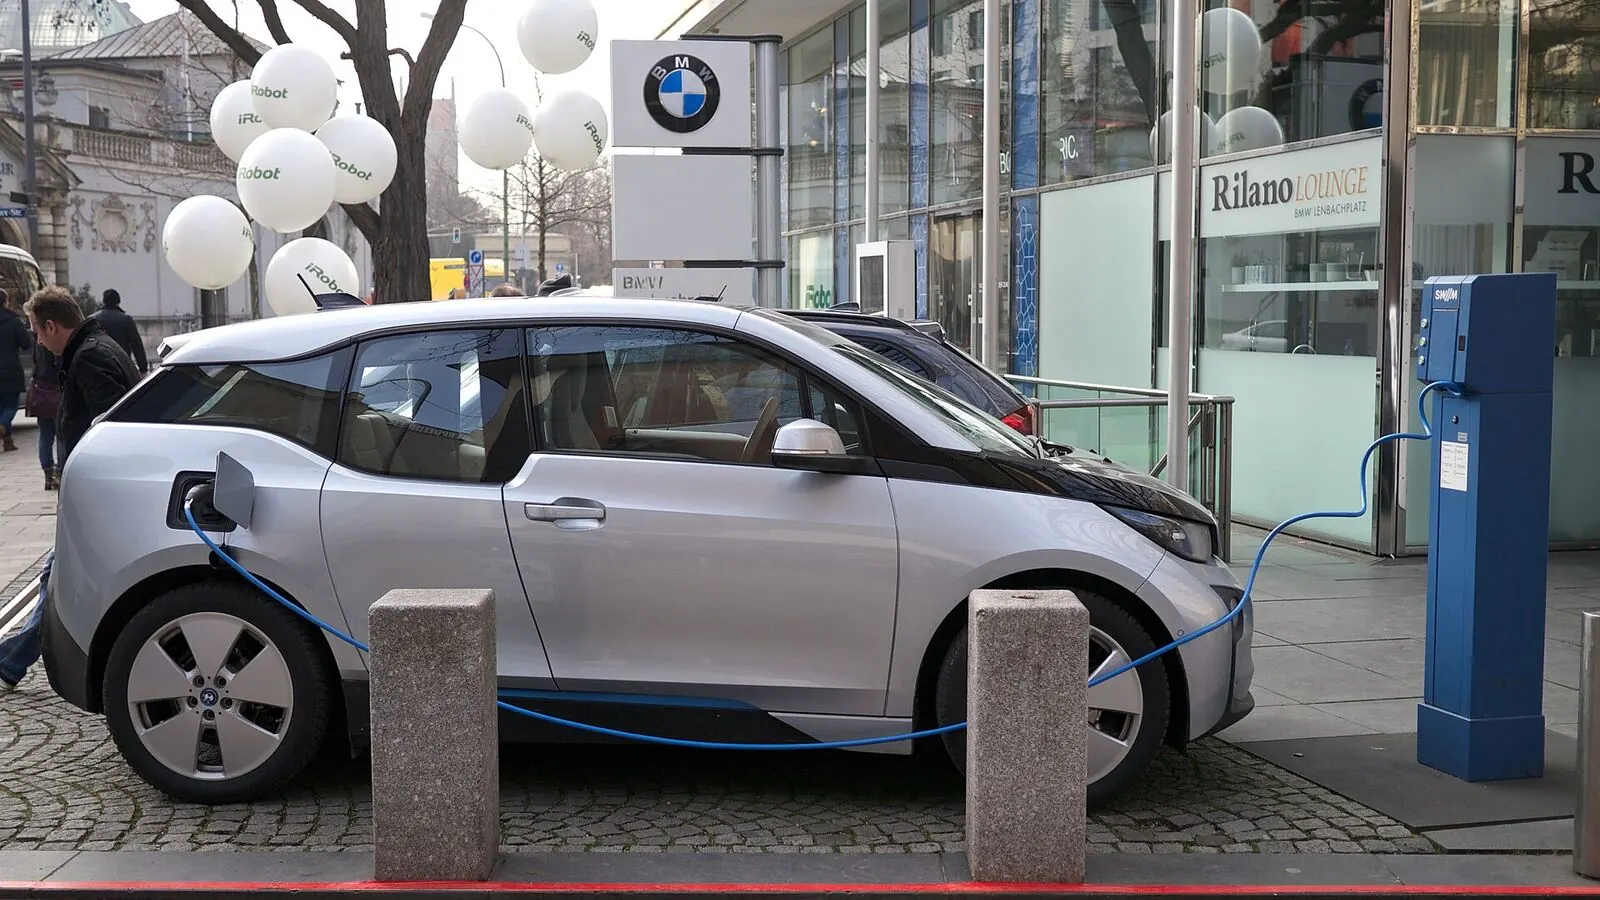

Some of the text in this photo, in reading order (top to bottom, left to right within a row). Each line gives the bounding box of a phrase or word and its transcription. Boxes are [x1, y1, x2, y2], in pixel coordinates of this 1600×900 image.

[651, 56, 714, 82] BMW
[251, 84, 288, 99] Robot
[239, 166, 281, 180] Robot
[1557, 152, 1600, 194] R
[1211, 166, 1368, 211] Rilano LOUNGE
[1294, 201, 1367, 218] BMW LENBACHPLATZ
[623, 276, 664, 289] BMW
